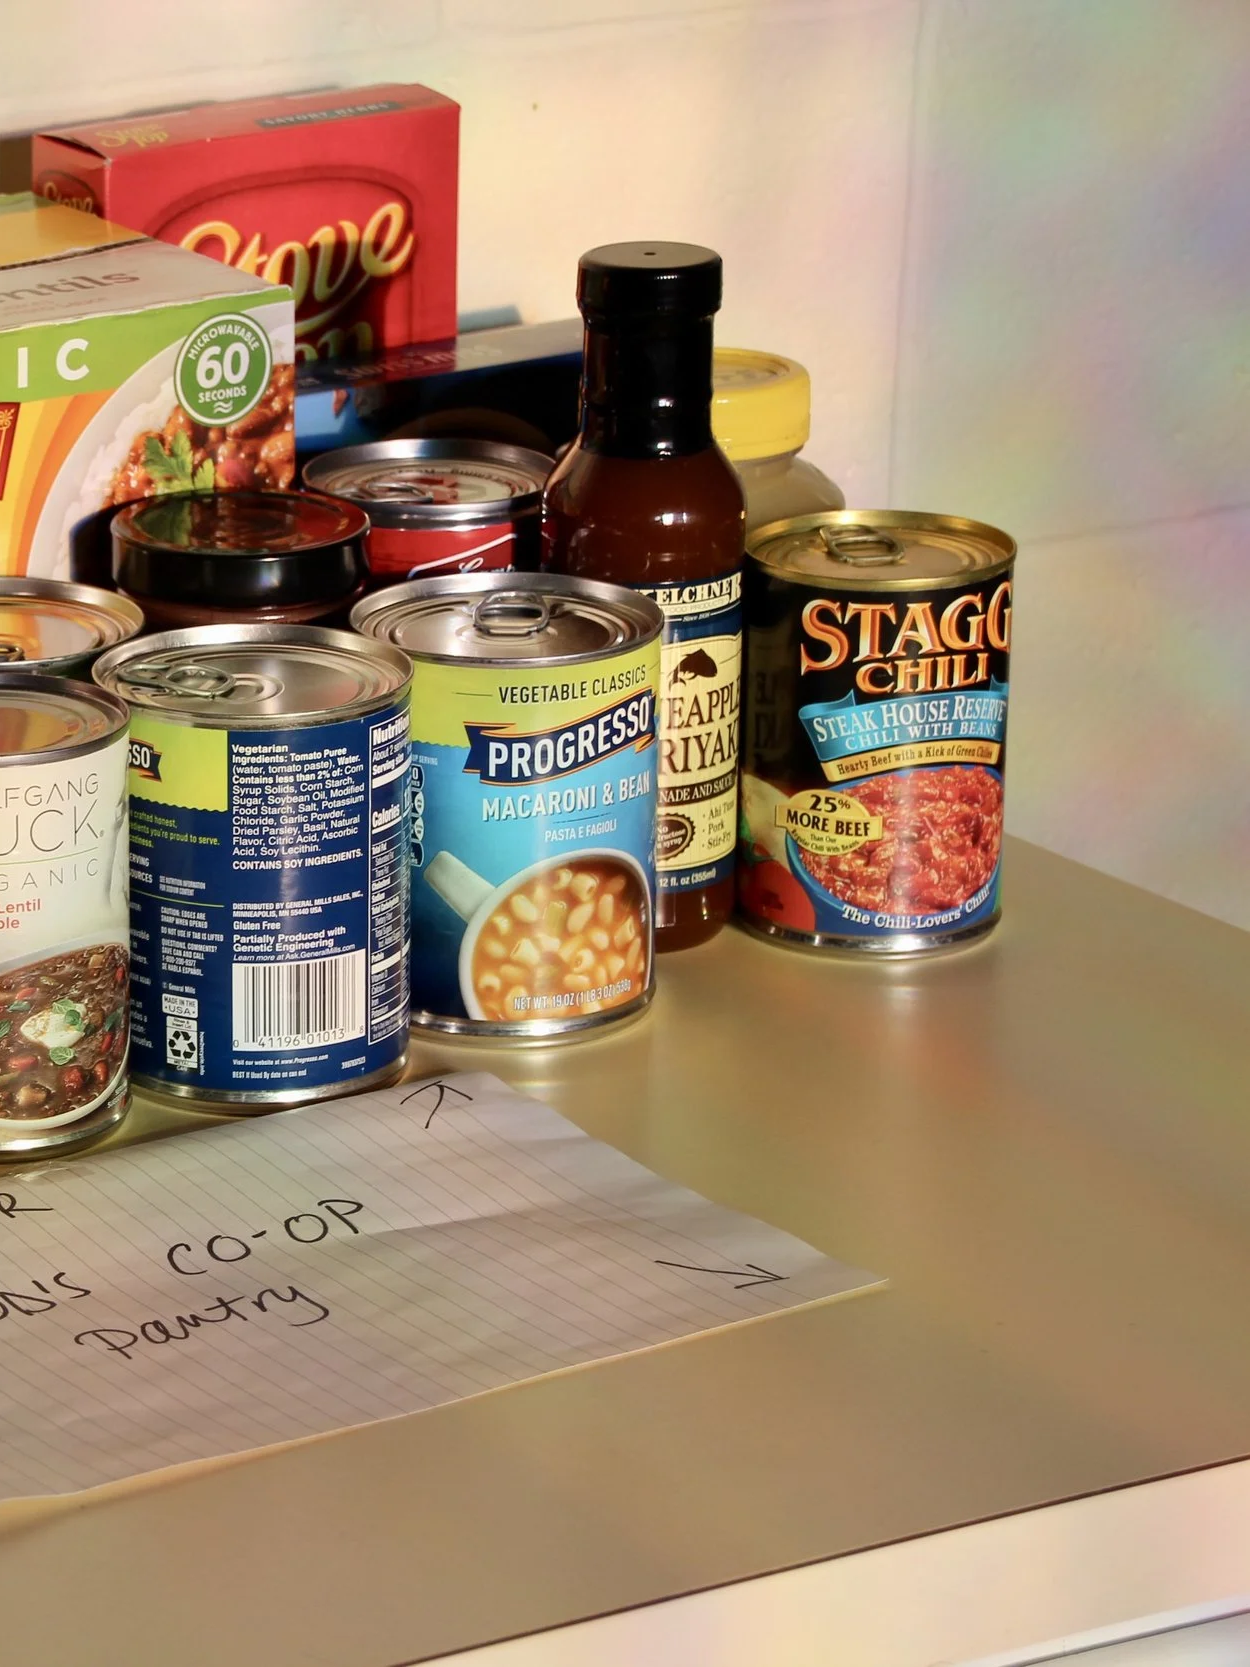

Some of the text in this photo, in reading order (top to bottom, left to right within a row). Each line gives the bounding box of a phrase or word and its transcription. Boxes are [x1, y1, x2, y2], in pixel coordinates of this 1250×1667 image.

[186, 324, 260, 361] MICROWAVABLE
[196, 344, 250, 389] 60
[198, 385, 248, 405] SECONDS
[801, 580, 1012, 676] STAGG
[498, 664, 647, 705] VEGETABLE CLASSICS
[856, 655, 990, 695] CHILI
[667, 682, 739, 730] EAPPL
[812, 694, 1006, 744] STEAK HOUSE RESERVE
[488, 696, 650, 779] PROGRESSO
[845, 714, 997, 751] CHILI WITH BEANS
[232, 744, 288, 755] Vegetarian
[233, 747, 347, 765] Ingredients: Tomato Puree
[837, 759, 869, 776] Hearty
[870, 752, 893, 768] Beef
[894, 749, 916, 762] with
[918, 750, 923, 758] a
[925, 745, 946, 758] Kick
[947, 746, 955, 758] of
[955, 744, 977, 758] Green
[232, 776, 354, 796] Syrup Solids, Corn Starch,
[482, 770, 651, 823] MACARONI & BEAN
[692, 783, 712, 799] AND
[713, 772, 733, 793] SAUCE
[372, 804, 400, 828] Calories
[809, 794, 850, 813] 25%
[544, 818, 617, 843] PASTA E FAGIOLI
[786, 809, 870, 837] MORE BEEF
[233, 848, 363, 869] CONTAINS SOY INGREDIENTS.
[659, 867, 716, 888] 12 fl. oz (355ml)
[842, 887, 991, 930] The Chili-Lovers' Chili!
[233, 921, 281, 930] Gluten Free
[233, 926, 346, 944] Partially Produced with
[233, 938, 334, 952] Genetic Engineering
[167, 1198, 364, 1276] CO-OP
